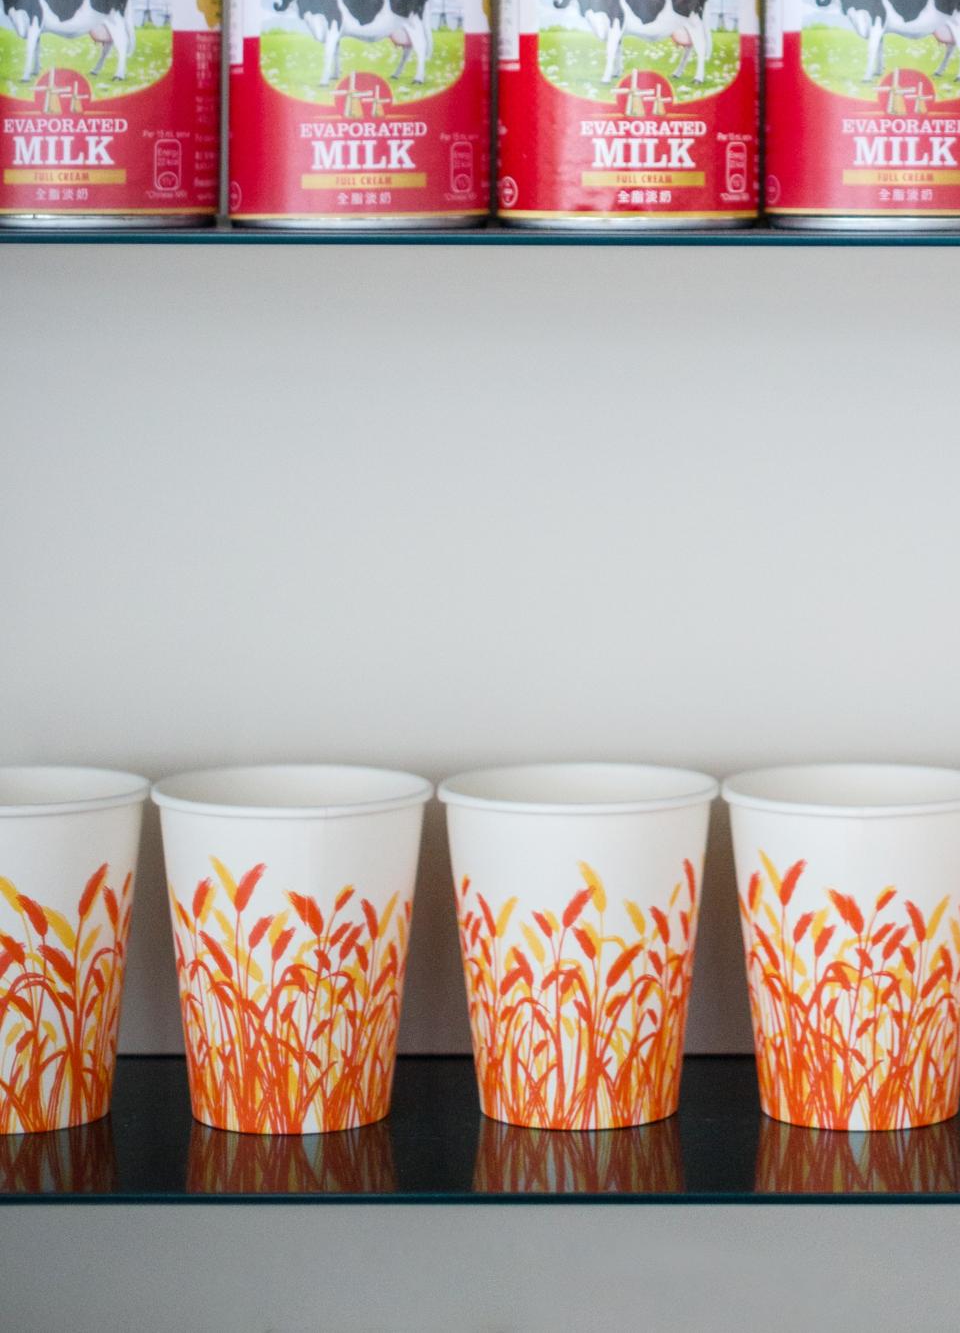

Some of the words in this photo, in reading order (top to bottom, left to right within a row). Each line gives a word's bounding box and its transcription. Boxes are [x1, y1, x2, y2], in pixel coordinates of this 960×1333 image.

[4, 118, 128, 133] EVAPORATED
[300, 122, 427, 138] EVAPORATED
[580, 121, 707, 136] EVAPORATED
[13, 136, 115, 165] MILK
[312, 140, 416, 170] MILK
[592, 138, 696, 169] MILK
[853, 136, 958, 166] MILK
